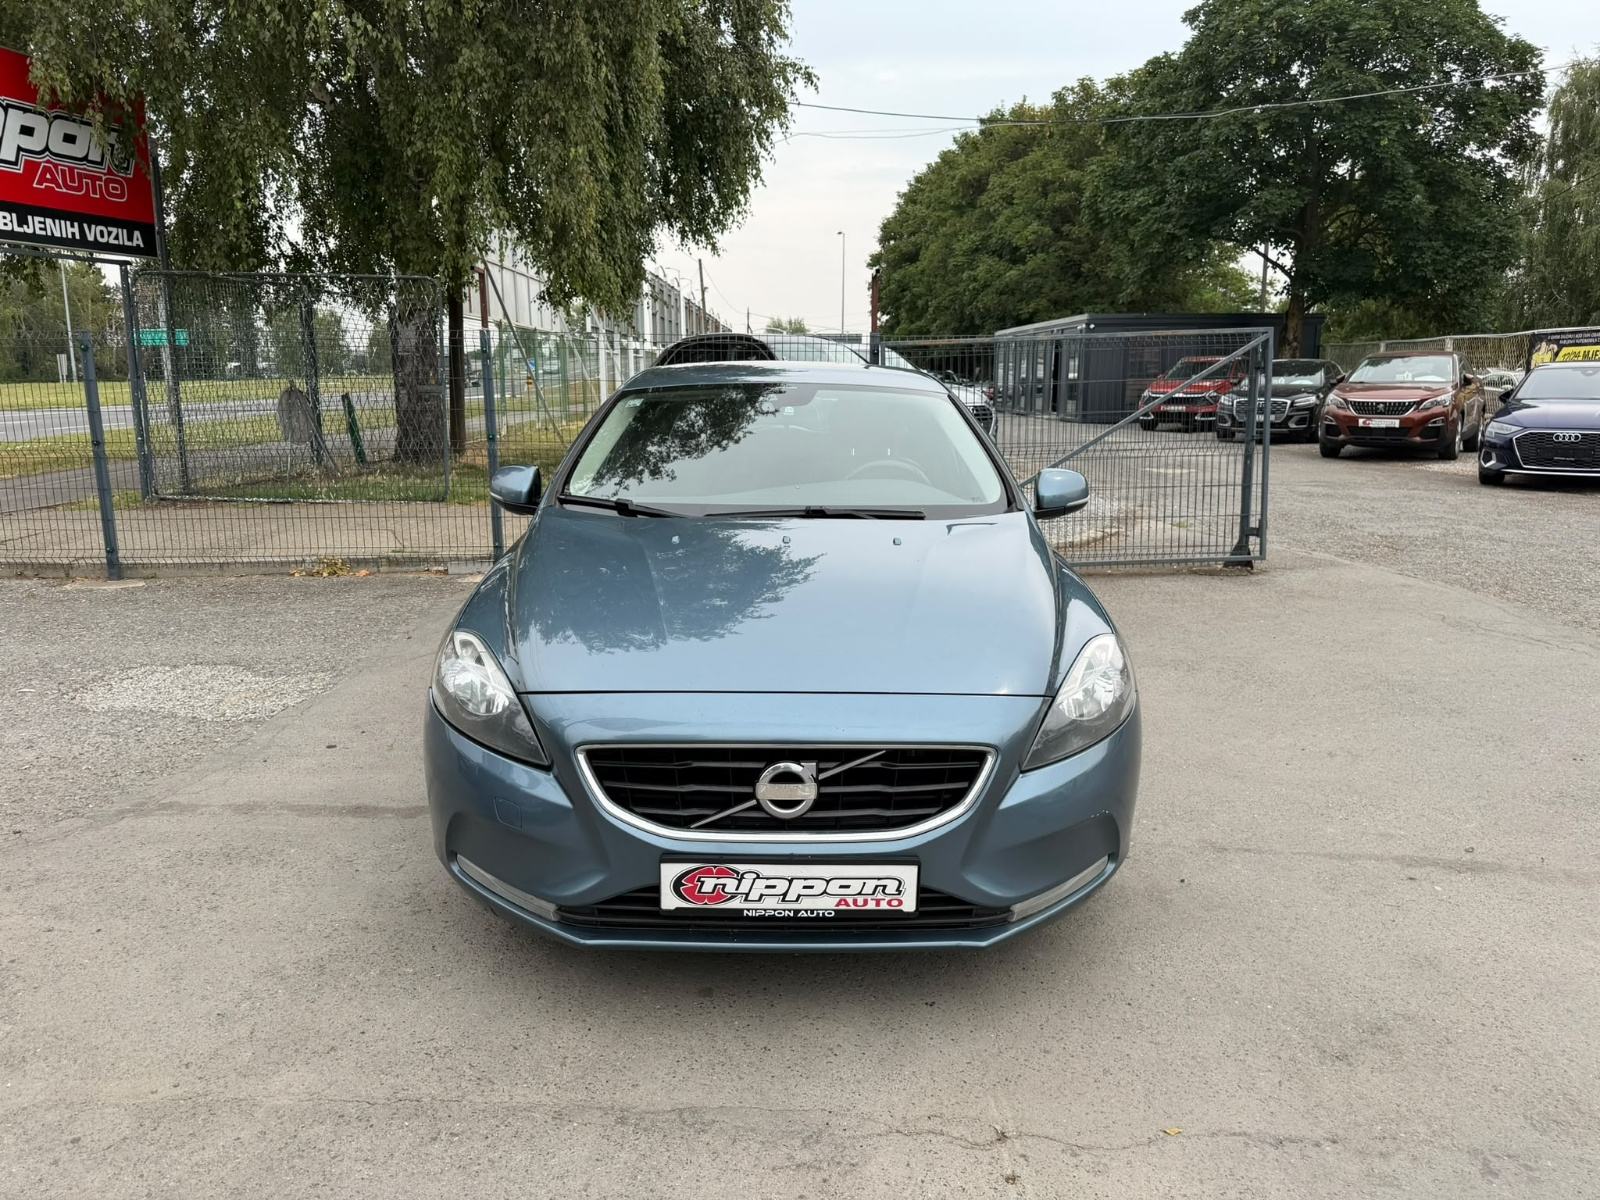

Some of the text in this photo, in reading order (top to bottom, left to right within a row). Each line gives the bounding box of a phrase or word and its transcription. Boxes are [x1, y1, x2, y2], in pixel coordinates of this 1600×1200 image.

[33, 163, 127, 201] AUTO
[83, 222, 144, 248] VOZILA
[697, 870, 905, 904] nippon
[743, 909, 835, 918] NIPPON AUTO
[834, 898, 903, 908] AUTO
